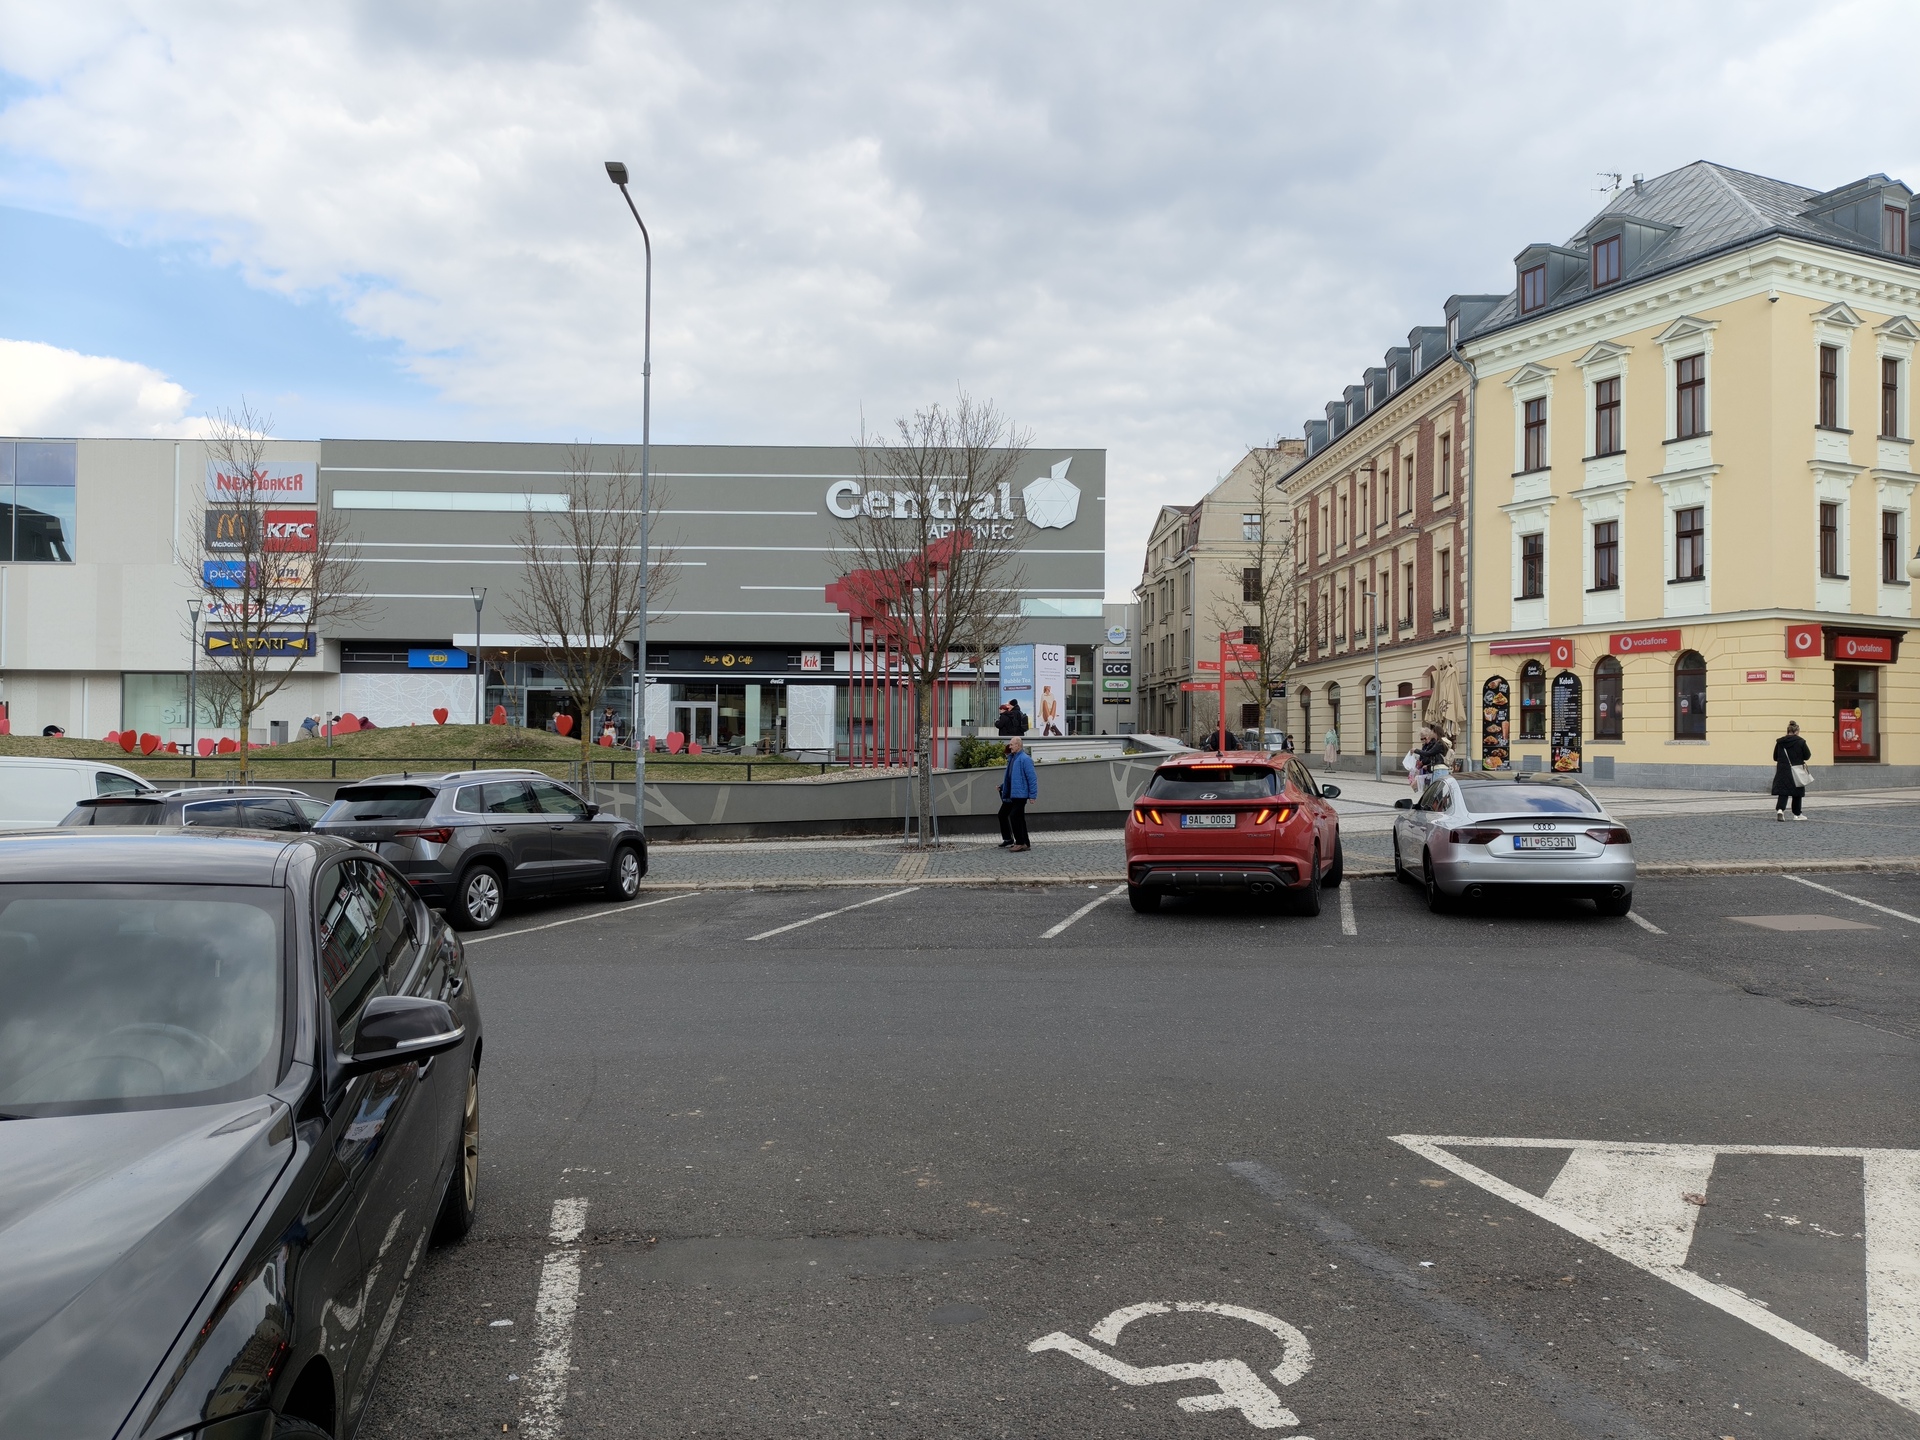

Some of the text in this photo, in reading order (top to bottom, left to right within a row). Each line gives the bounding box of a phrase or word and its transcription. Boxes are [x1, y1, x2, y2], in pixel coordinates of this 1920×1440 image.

[825, 480, 1015, 520] Central
[264, 522, 315, 539] KFC
[920, 523, 1015, 541] ABONEC
[278, 567, 299, 578] dm
[231, 637, 289, 650] DTART
[1633, 637, 1668, 646] vodafone
[1857, 644, 1883, 653] vodafone
[804, 655, 818, 668] kik
[1041, 651, 1059, 662] CCC
[1105, 664, 1128, 673] CCC
[1188, 814, 1232, 824] 9AL 0063
[1521, 837, 1575, 847] MI 653FN
